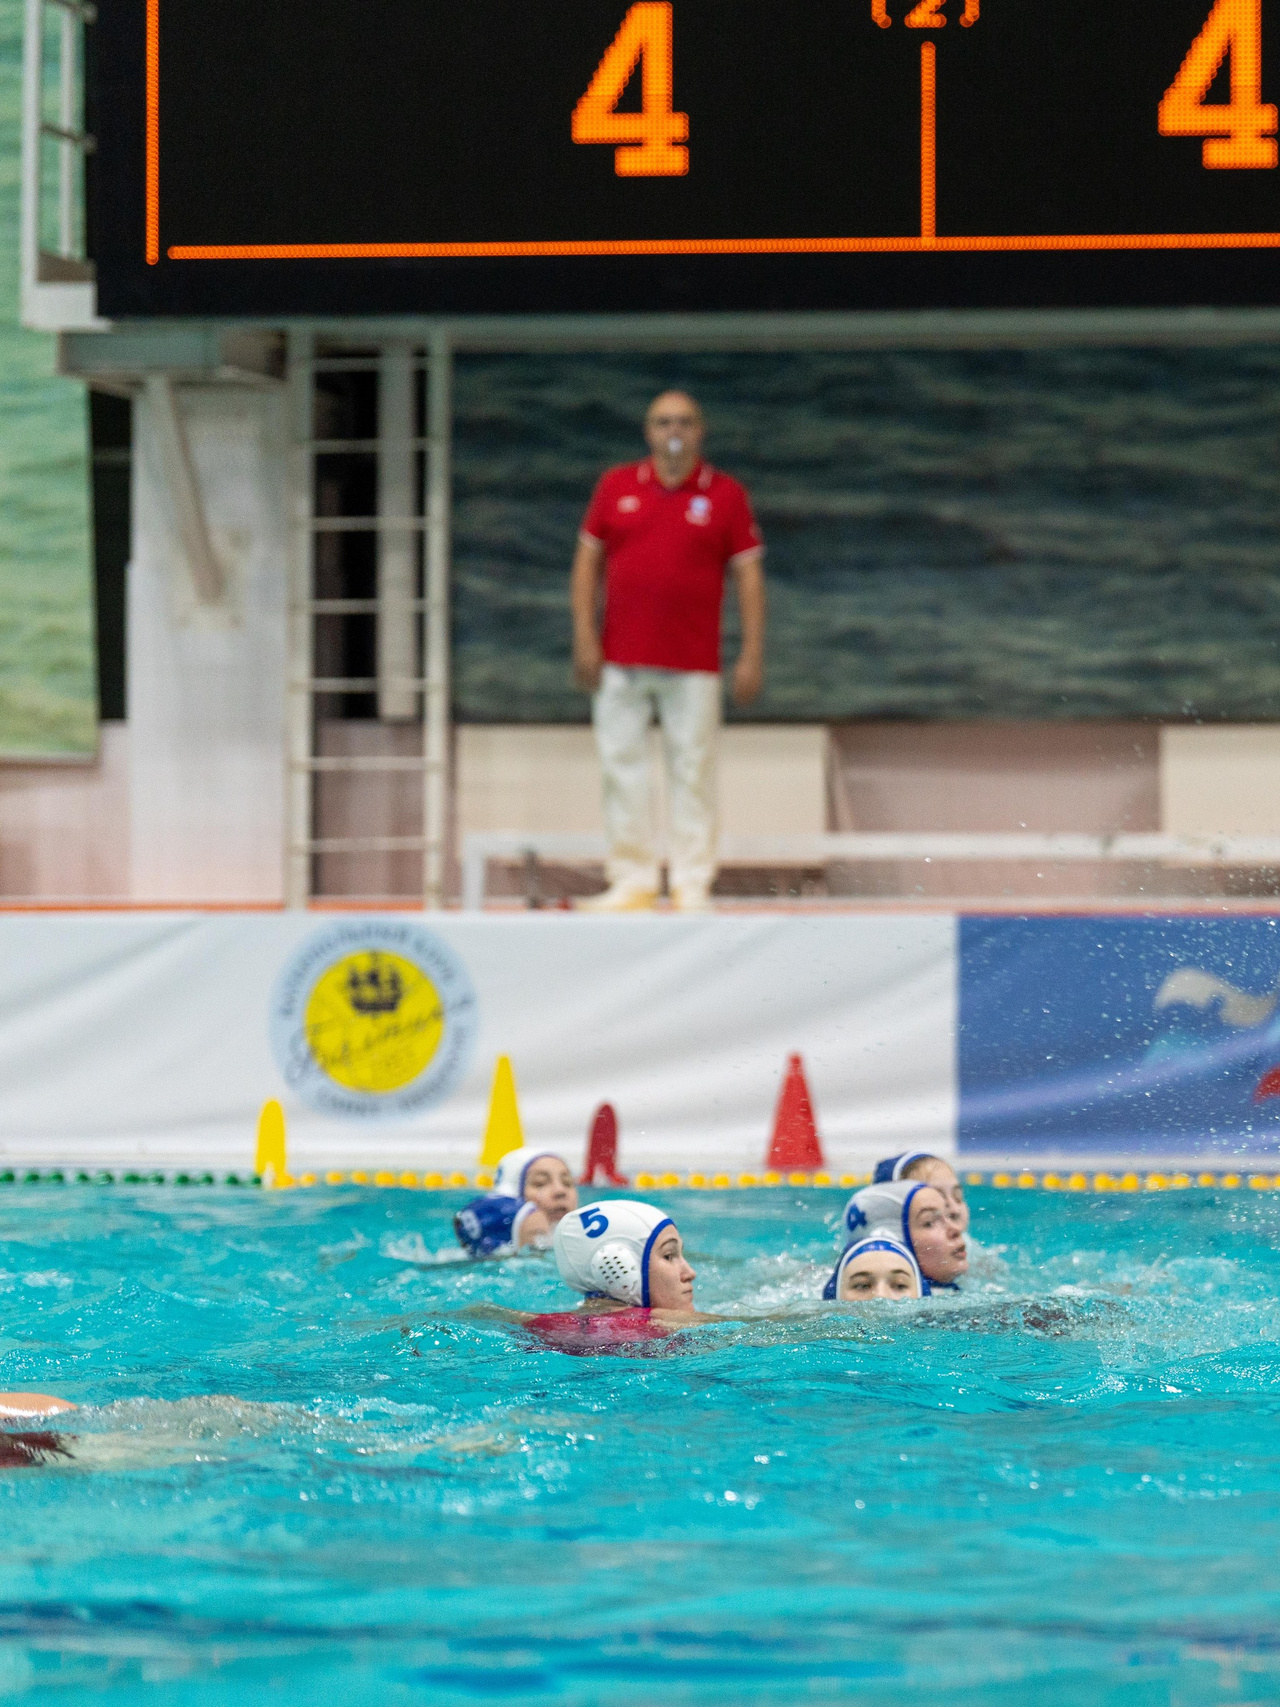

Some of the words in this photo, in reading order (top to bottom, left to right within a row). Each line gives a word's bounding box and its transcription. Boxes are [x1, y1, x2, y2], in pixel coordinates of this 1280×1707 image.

[571, 1, 690, 177] 4
[1158, 0, 1279, 169] 4
[579, 1206, 609, 1239] 5
[846, 1203, 868, 1232] 4
